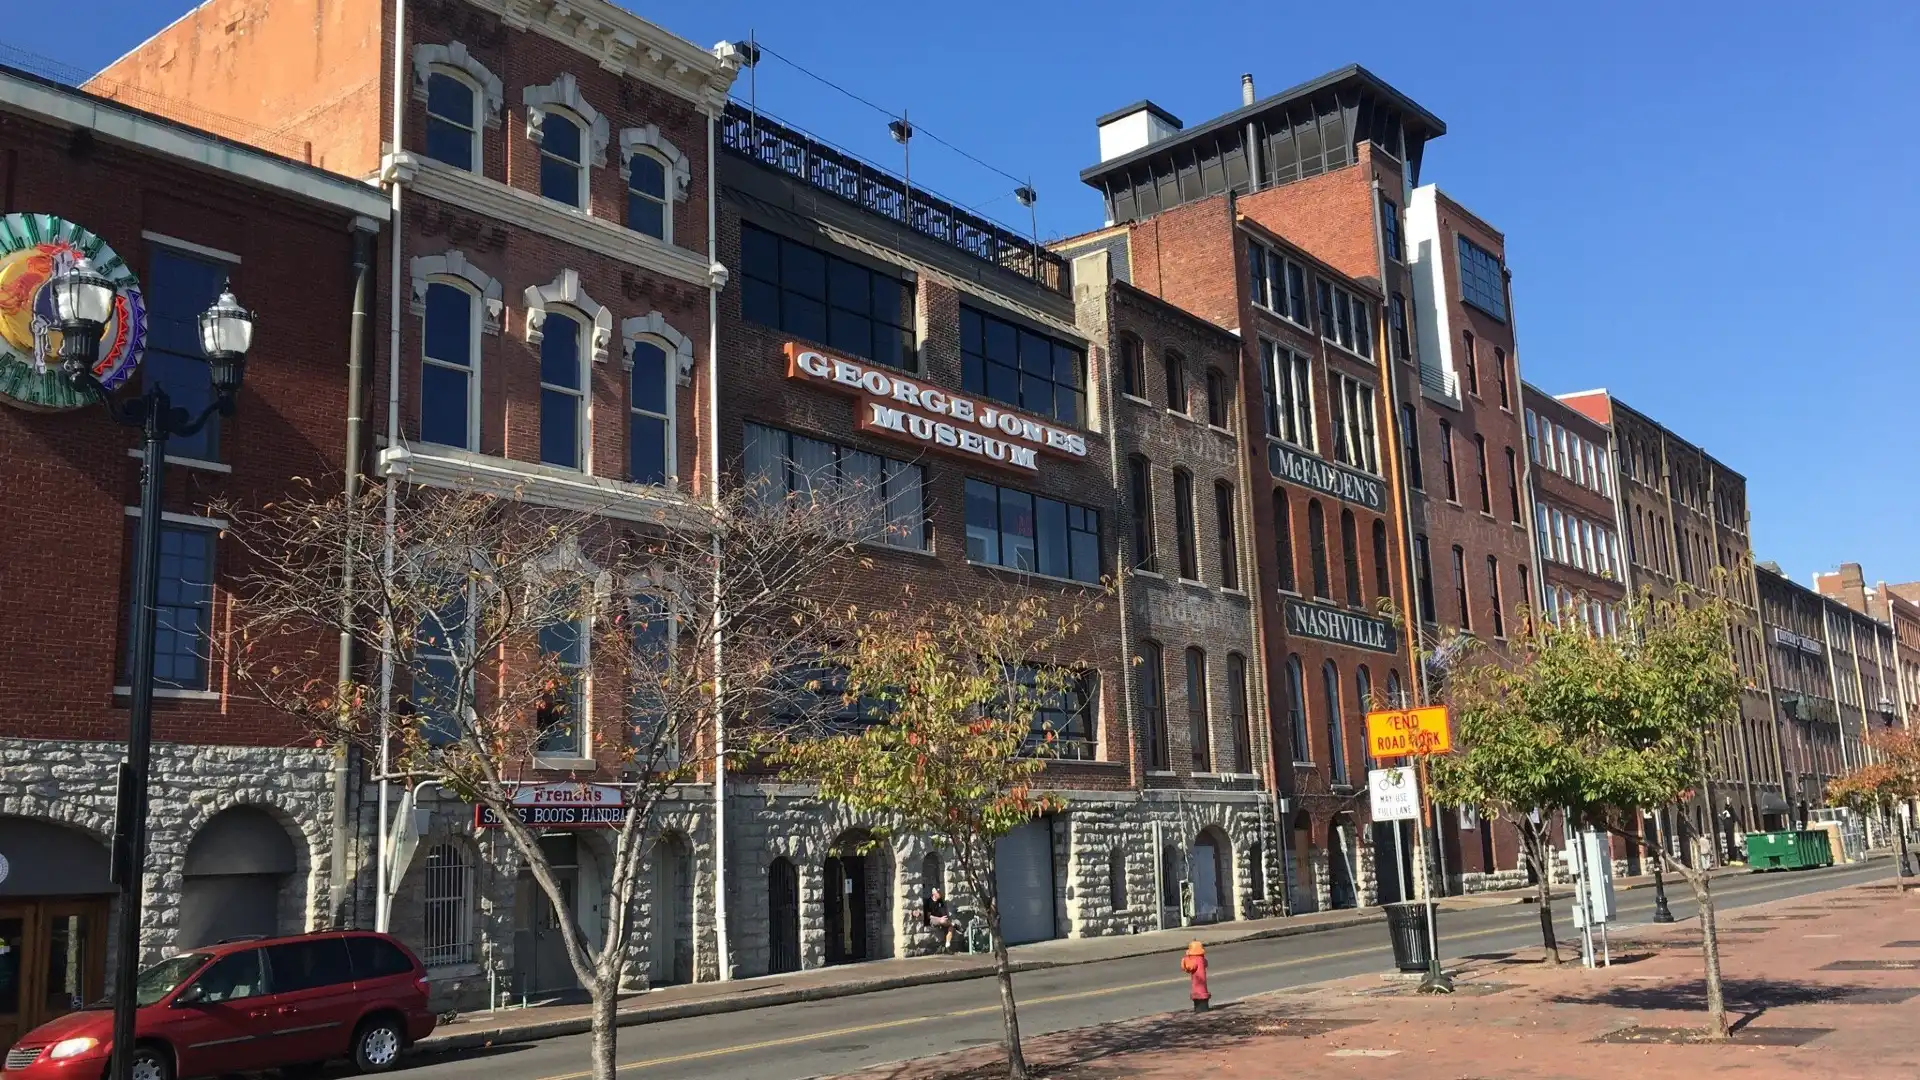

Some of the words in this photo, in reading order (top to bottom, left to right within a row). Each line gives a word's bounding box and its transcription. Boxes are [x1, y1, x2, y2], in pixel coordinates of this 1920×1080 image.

[797, 351, 975, 423] GEORGE
[979, 406, 1087, 457] JONES
[869, 403, 1039, 471] MUSEUM
[1278, 448, 1379, 507] McFADDEN'S
[1293, 605, 1387, 649] NASHVILLE
[1394, 714, 1419, 730] END
[1377, 735, 1406, 750] ROAD
[534, 786, 602, 803] French's
[1396, 792, 1408, 803] USE
[534, 808, 575, 823] BOOTS
